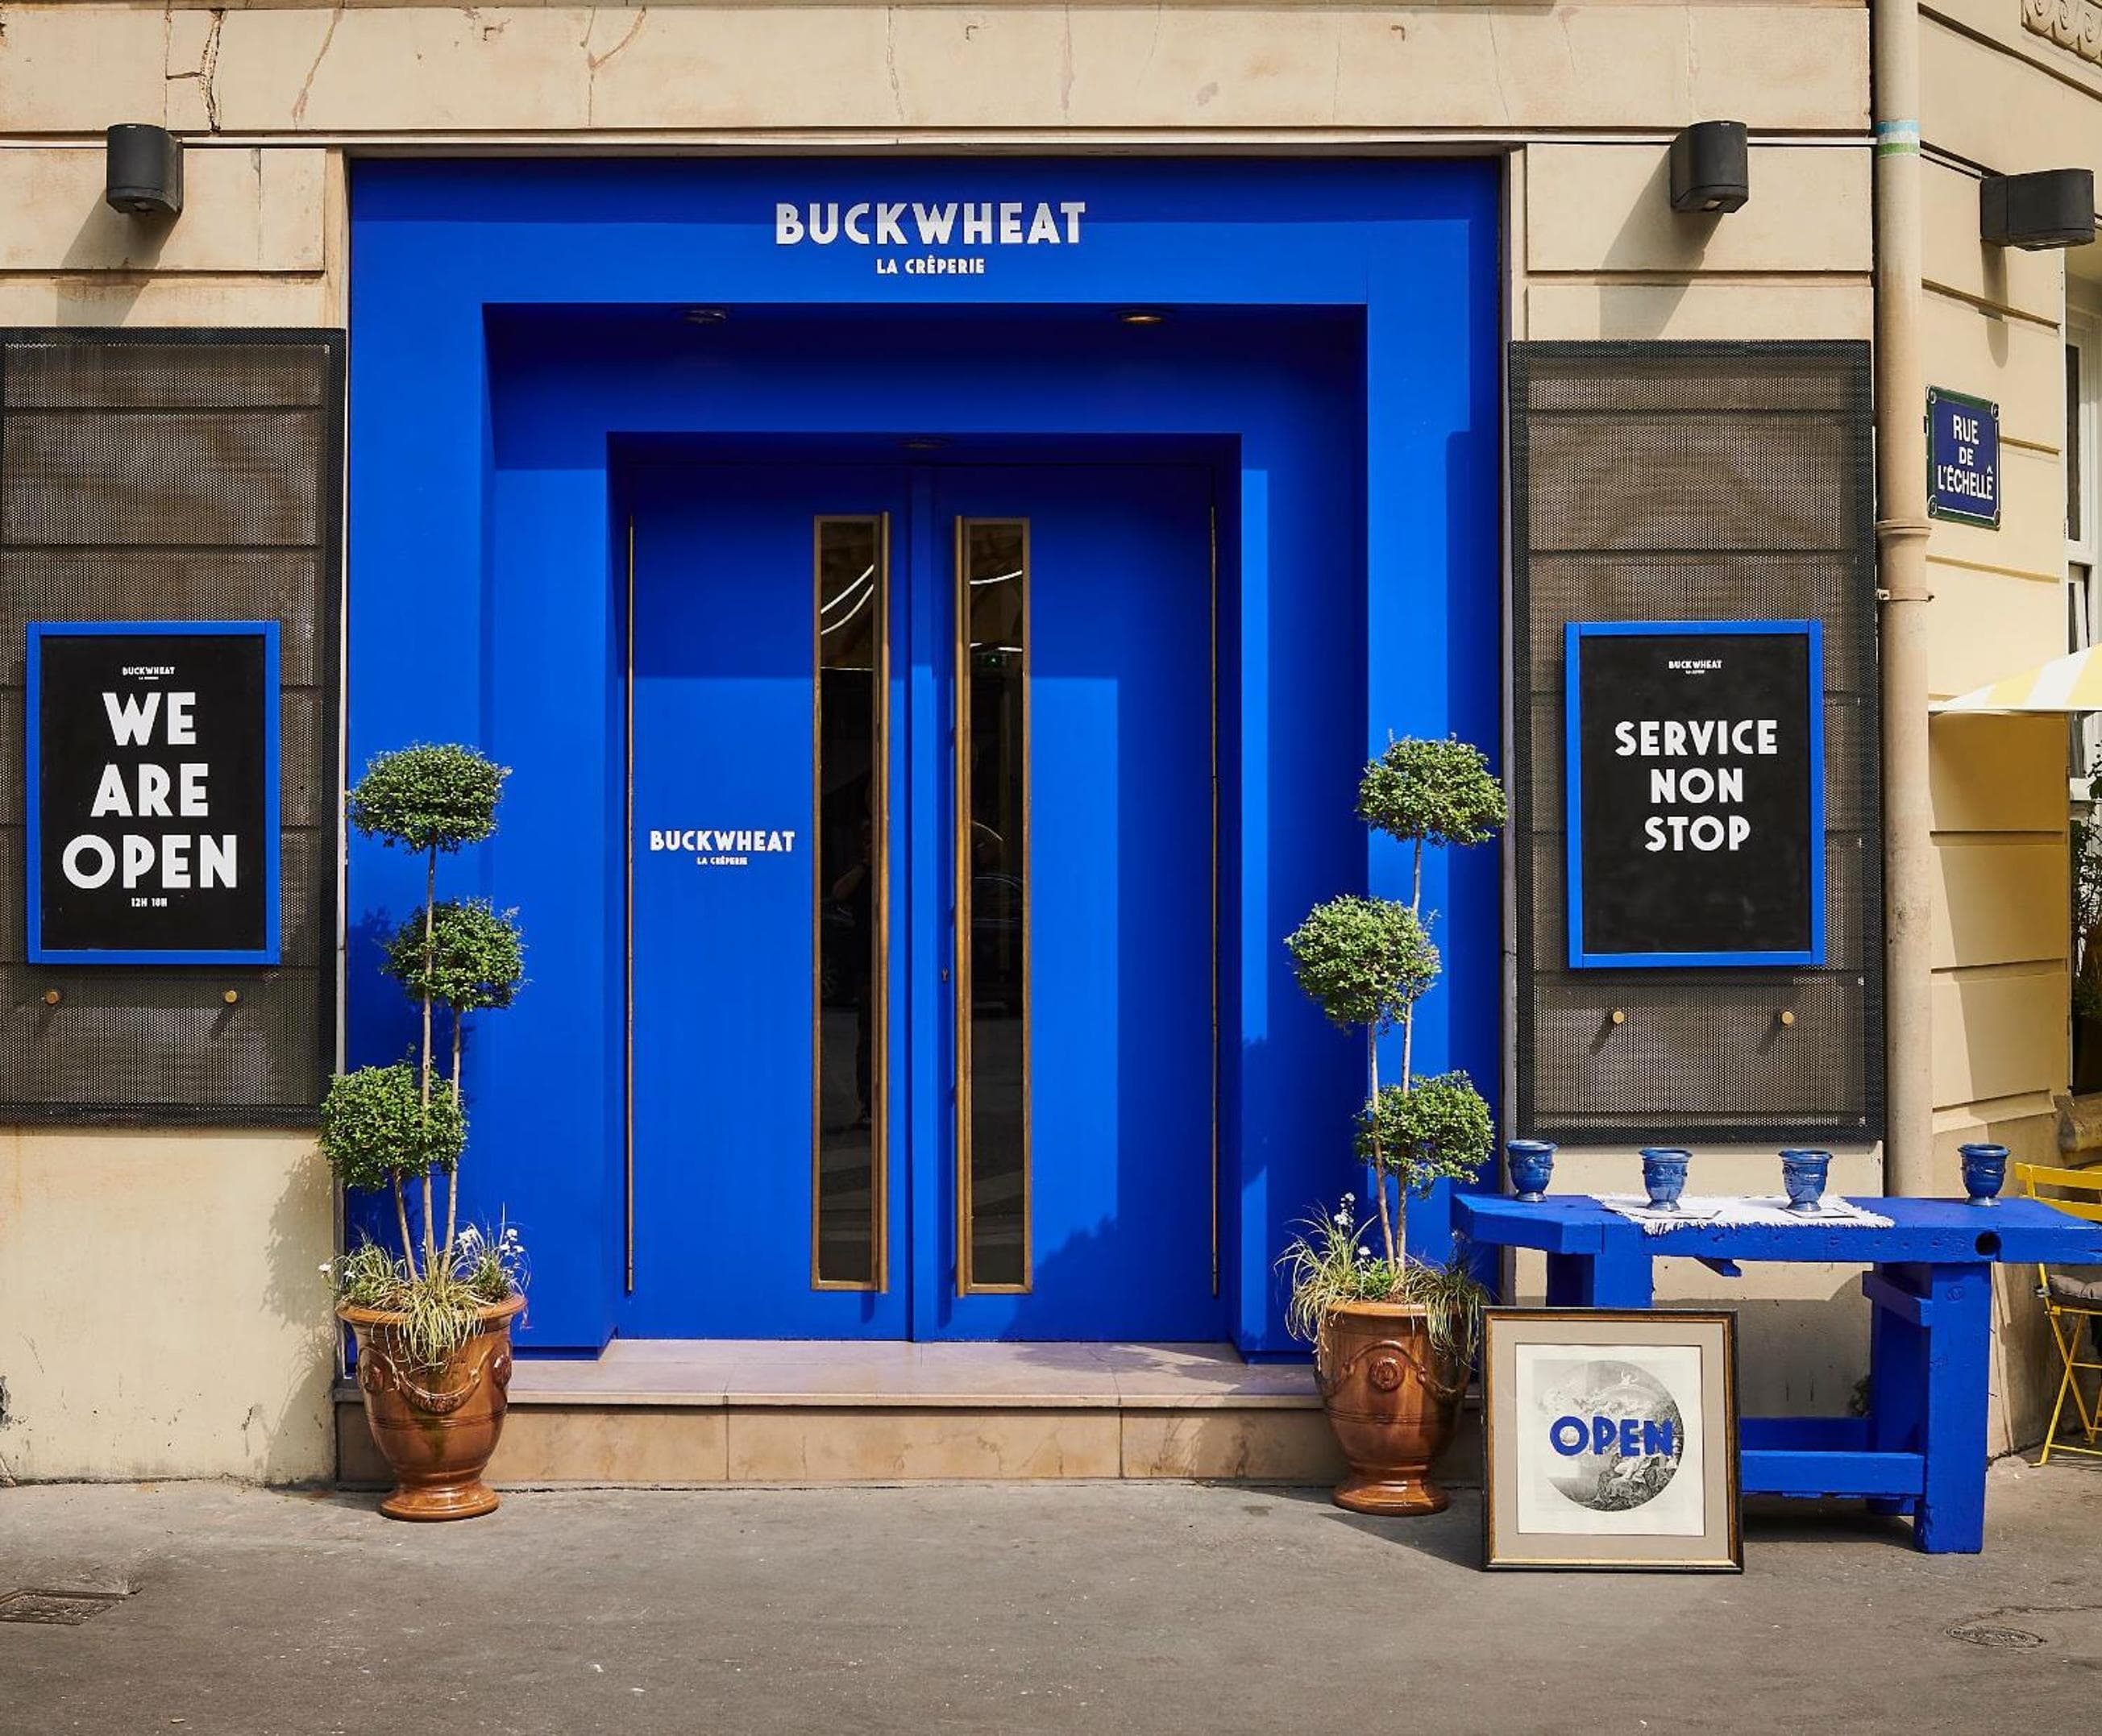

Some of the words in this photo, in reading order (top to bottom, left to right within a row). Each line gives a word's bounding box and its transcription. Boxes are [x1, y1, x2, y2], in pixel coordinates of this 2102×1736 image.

[776, 201, 1086, 245] BUCKWHEAT
[876, 258, 898, 274] LA
[905, 255, 985, 274] CRÊPERIE
[1953, 414, 1979, 445] RUE
[1959, 446, 1974, 467] DE
[1668, 659, 1722, 669] BUCKWHEAT
[102, 691, 197, 746] WE
[1614, 719, 1778, 756] SERVICE
[89, 762, 209, 817] ARE
[1650, 767, 1743, 804] NON
[650, 830, 796, 852] BUCKWHEAT
[1644, 815, 1751, 853] STOP
[62, 834, 237, 889] OPEN
[696, 857, 708, 866] LA
[131, 897, 148, 907] 12H
[1550, 1415, 1673, 1457] OPEN
